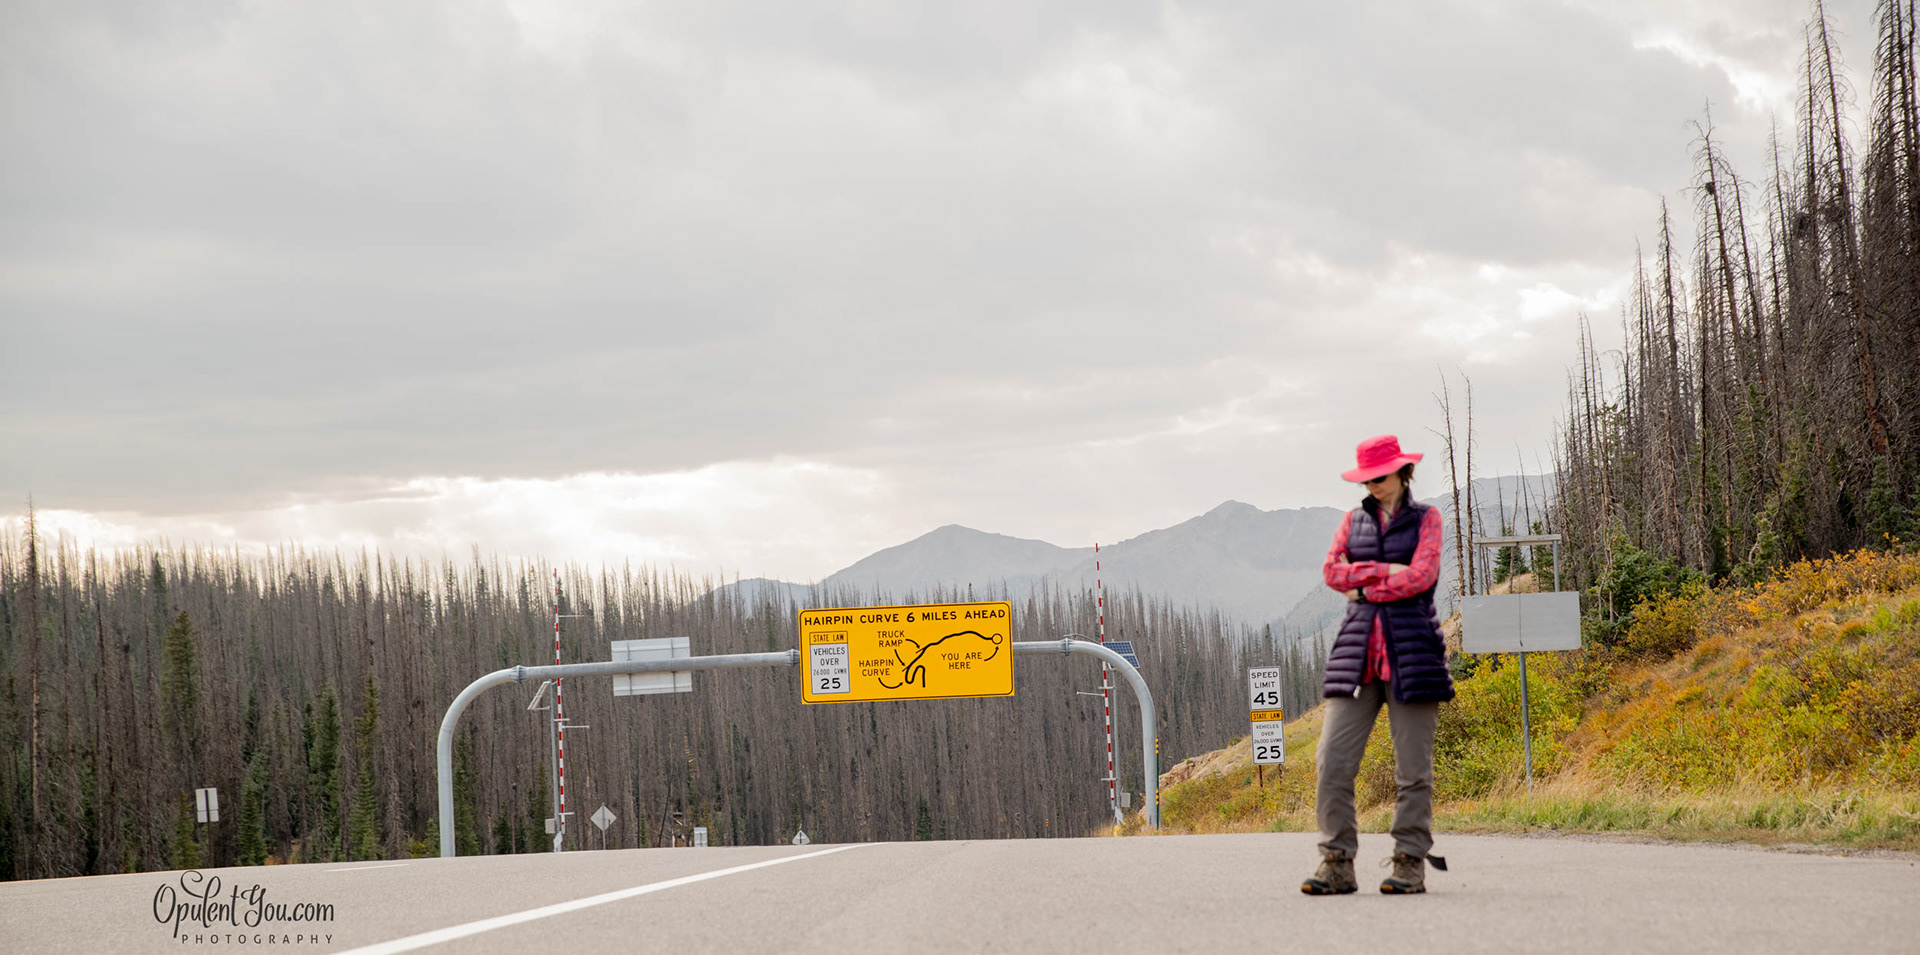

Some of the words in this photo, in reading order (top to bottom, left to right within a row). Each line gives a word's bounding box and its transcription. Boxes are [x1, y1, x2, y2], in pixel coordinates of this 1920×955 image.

[804, 615, 853, 626] HAIRPIN
[860, 613, 900, 624] CURVE
[906, 613, 915, 622] 6
[922, 611, 957, 621] MILES
[964, 609, 1005, 620] AHEAD
[813, 634, 829, 642] STATE
[877, 630, 905, 639] TRUCK
[878, 640, 903, 648] RAMP
[813, 647, 846, 656] VEHICLES
[941, 652, 962, 661] YOU
[965, 651, 982, 660] ARE
[820, 658, 839, 666] OVER
[858, 659, 894, 668] HAIRPIN
[948, 661, 971, 670] HERE
[861, 668, 891, 677] CURVE
[1251, 671, 1278, 679] SPEED
[820, 677, 841, 690] 25
[1254, 681, 1275, 689] LIMIT
[1253, 691, 1279, 705] 45
[1253, 712, 1267, 720] STATE
[1257, 745, 1281, 760] 25
